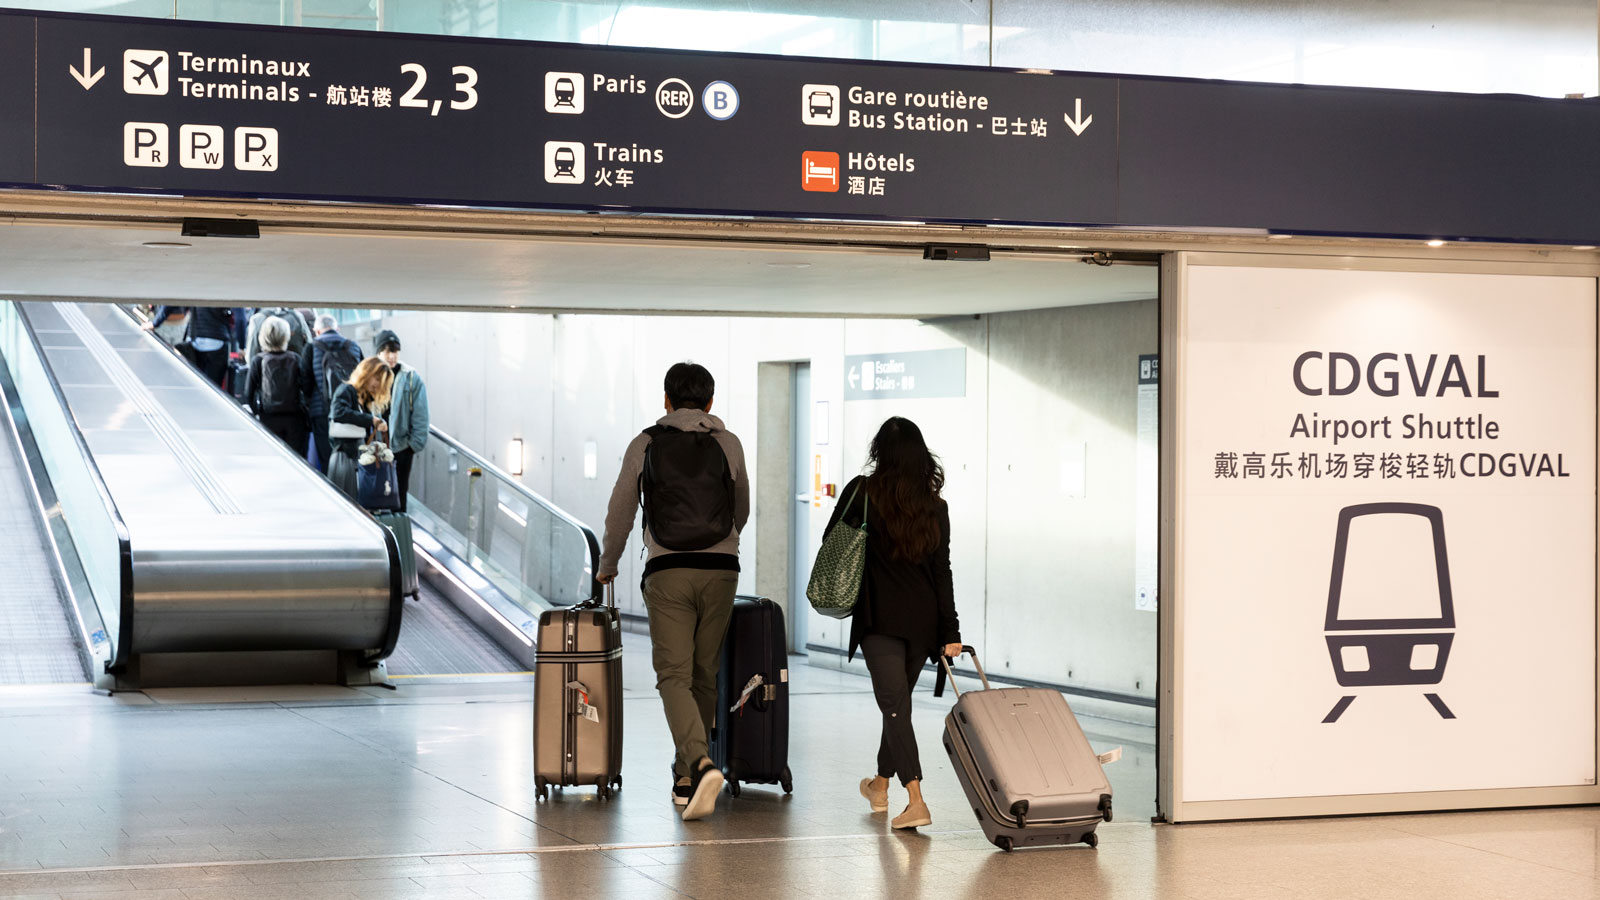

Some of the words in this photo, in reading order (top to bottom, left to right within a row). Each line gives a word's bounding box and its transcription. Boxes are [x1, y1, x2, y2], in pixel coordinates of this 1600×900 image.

[178, 51, 311, 77] Terminaux
[178, 77, 300, 103] Terminals
[326, 84, 392, 107] 航站楼
[399, 62, 479, 117] 2,3
[593, 73, 647, 94] Paris
[661, 90, 689, 107] RER
[714, 91, 729, 111] B
[848, 85, 897, 107] Gare
[905, 90, 989, 111] routière
[848, 109, 886, 129] Bus
[893, 111, 969, 133] Station
[991, 116, 1048, 138] 巴士站
[593, 142, 664, 164] Trains
[848, 151, 915, 173] Hôtels
[594, 167, 634, 188] 火车
[847, 175, 886, 196] 酒店
[1292, 350, 1500, 398] CDGVAL
[1289, 412, 1392, 446] Airport
[1402, 412, 1500, 440] Shuttle
